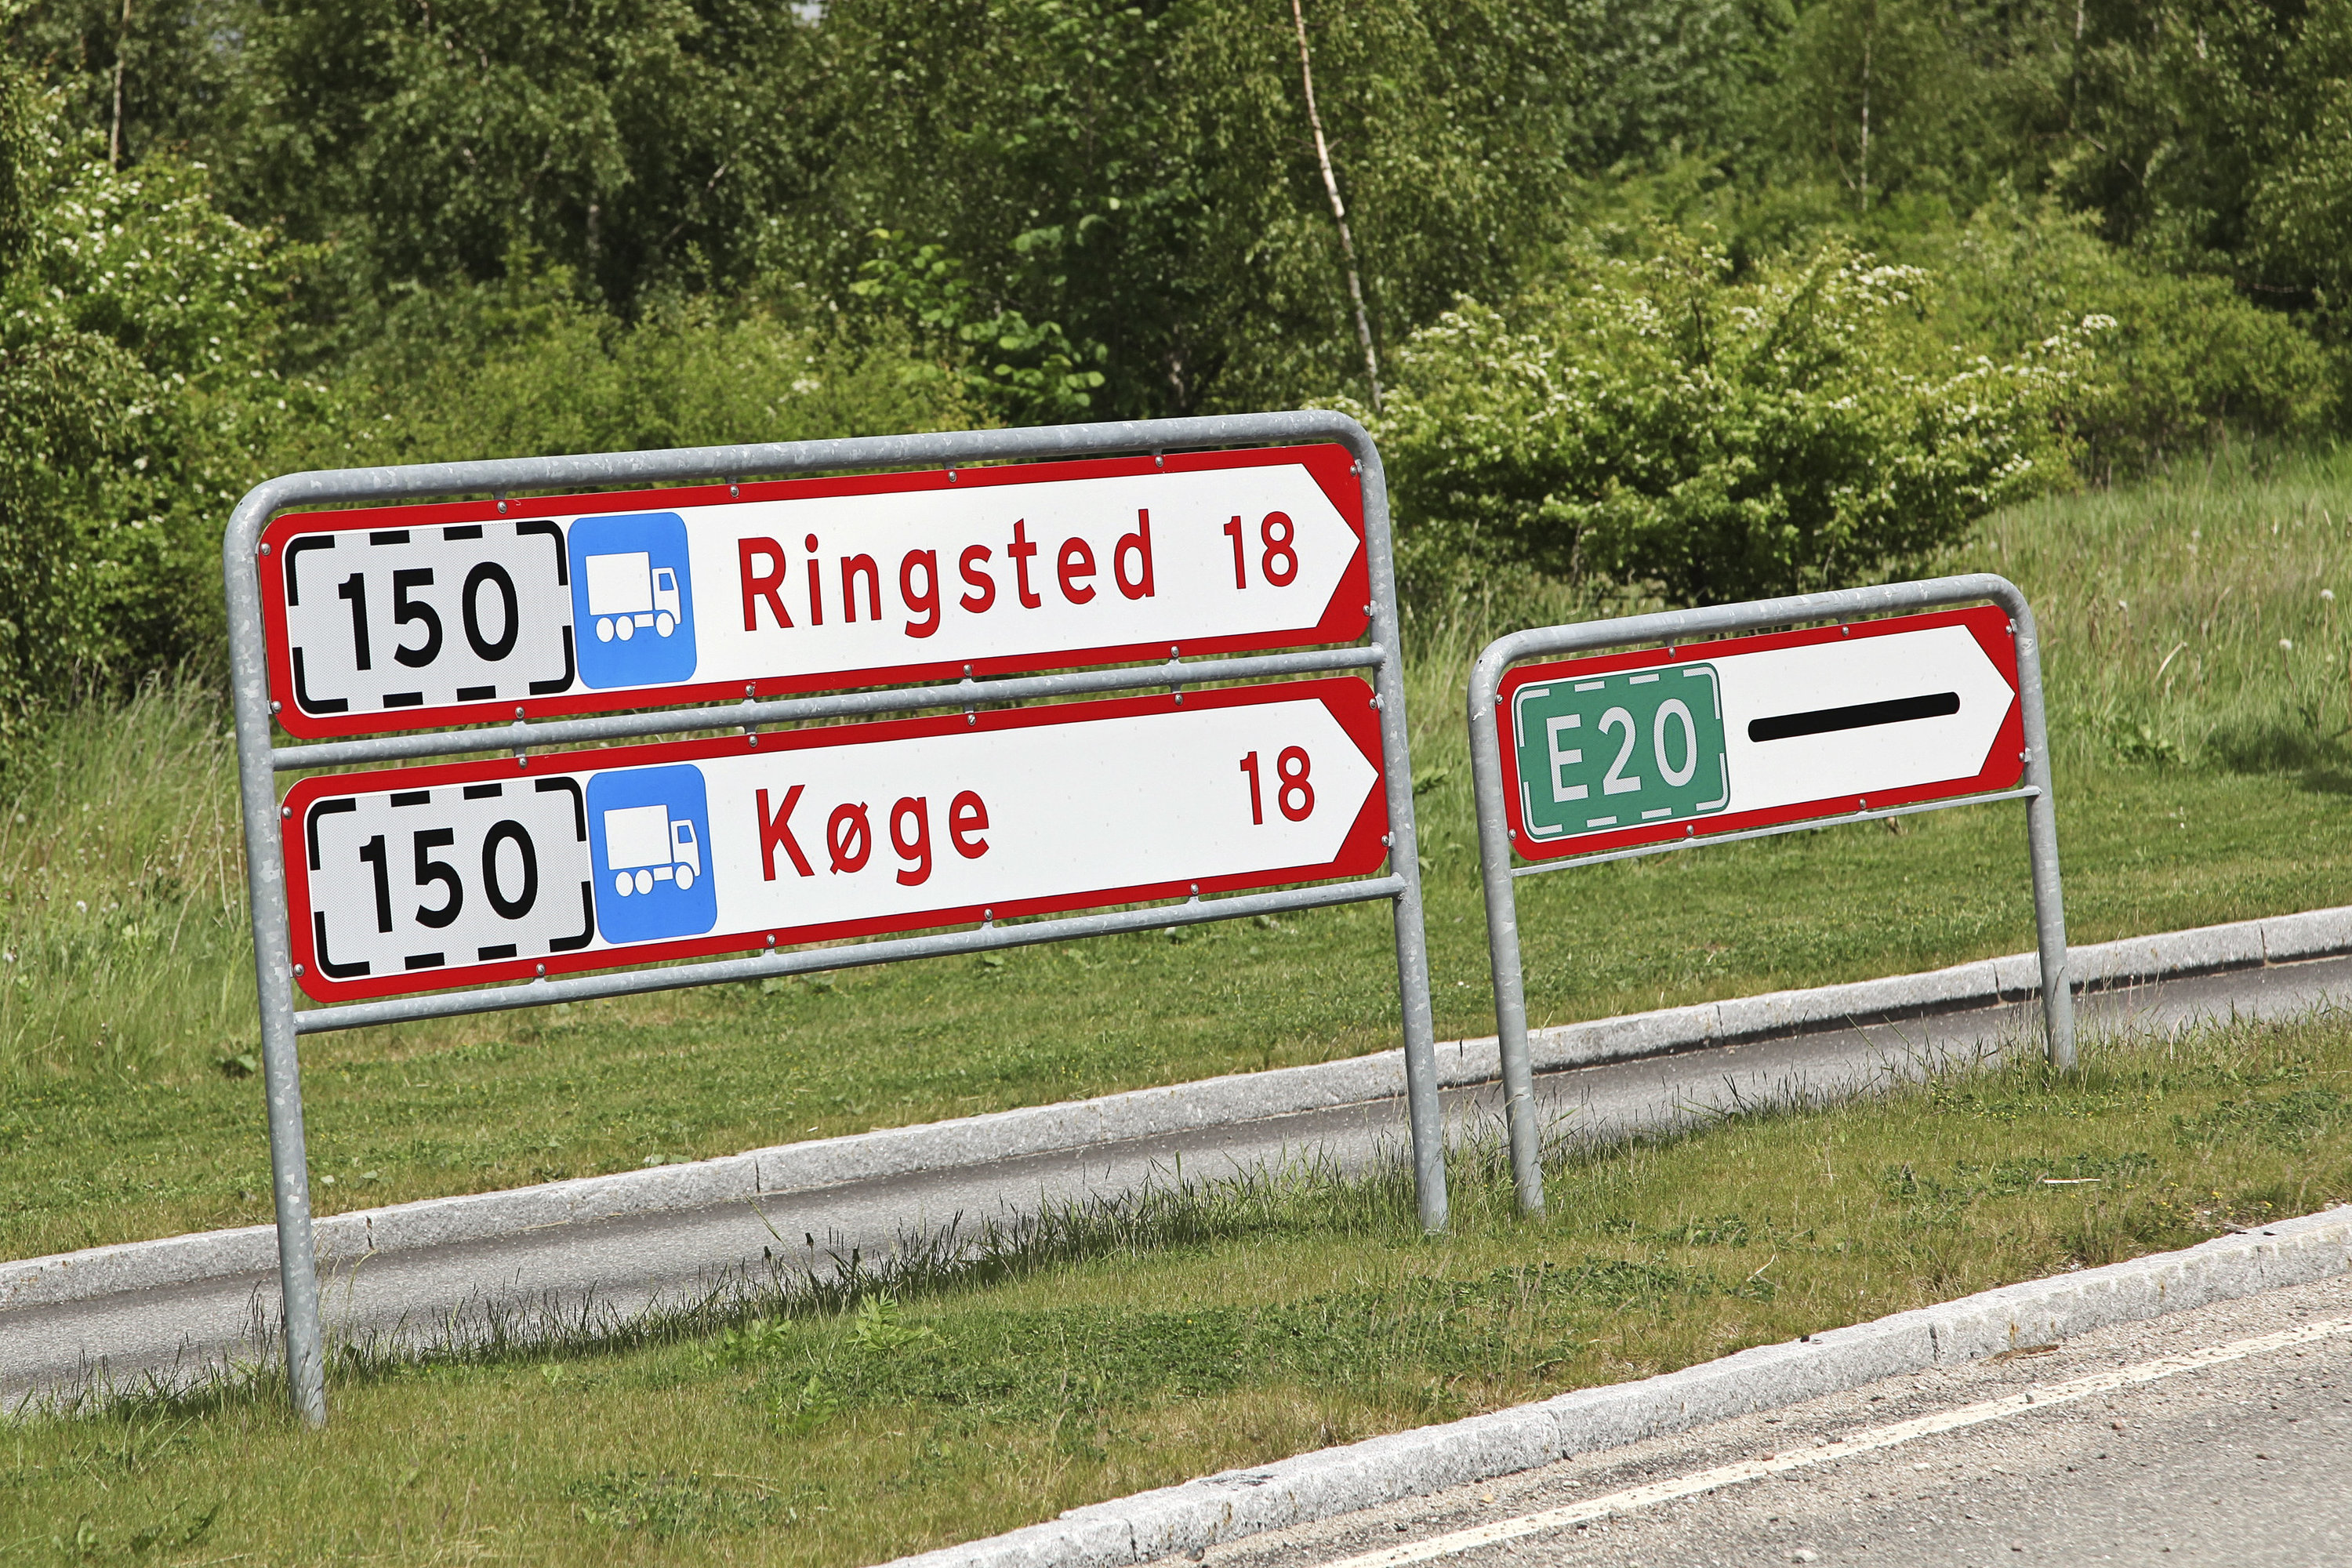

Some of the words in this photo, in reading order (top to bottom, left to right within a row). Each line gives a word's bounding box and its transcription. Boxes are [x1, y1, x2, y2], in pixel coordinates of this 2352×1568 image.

[336, 560, 521, 673] 150
[737, 506, 1156, 641] Ringsted
[1223, 509, 1300, 591] 18
[1544, 696, 1699, 804] E20
[358, 818, 540, 935] 150
[755, 782, 991, 888] Køge
[1240, 744, 1316, 827] 18
